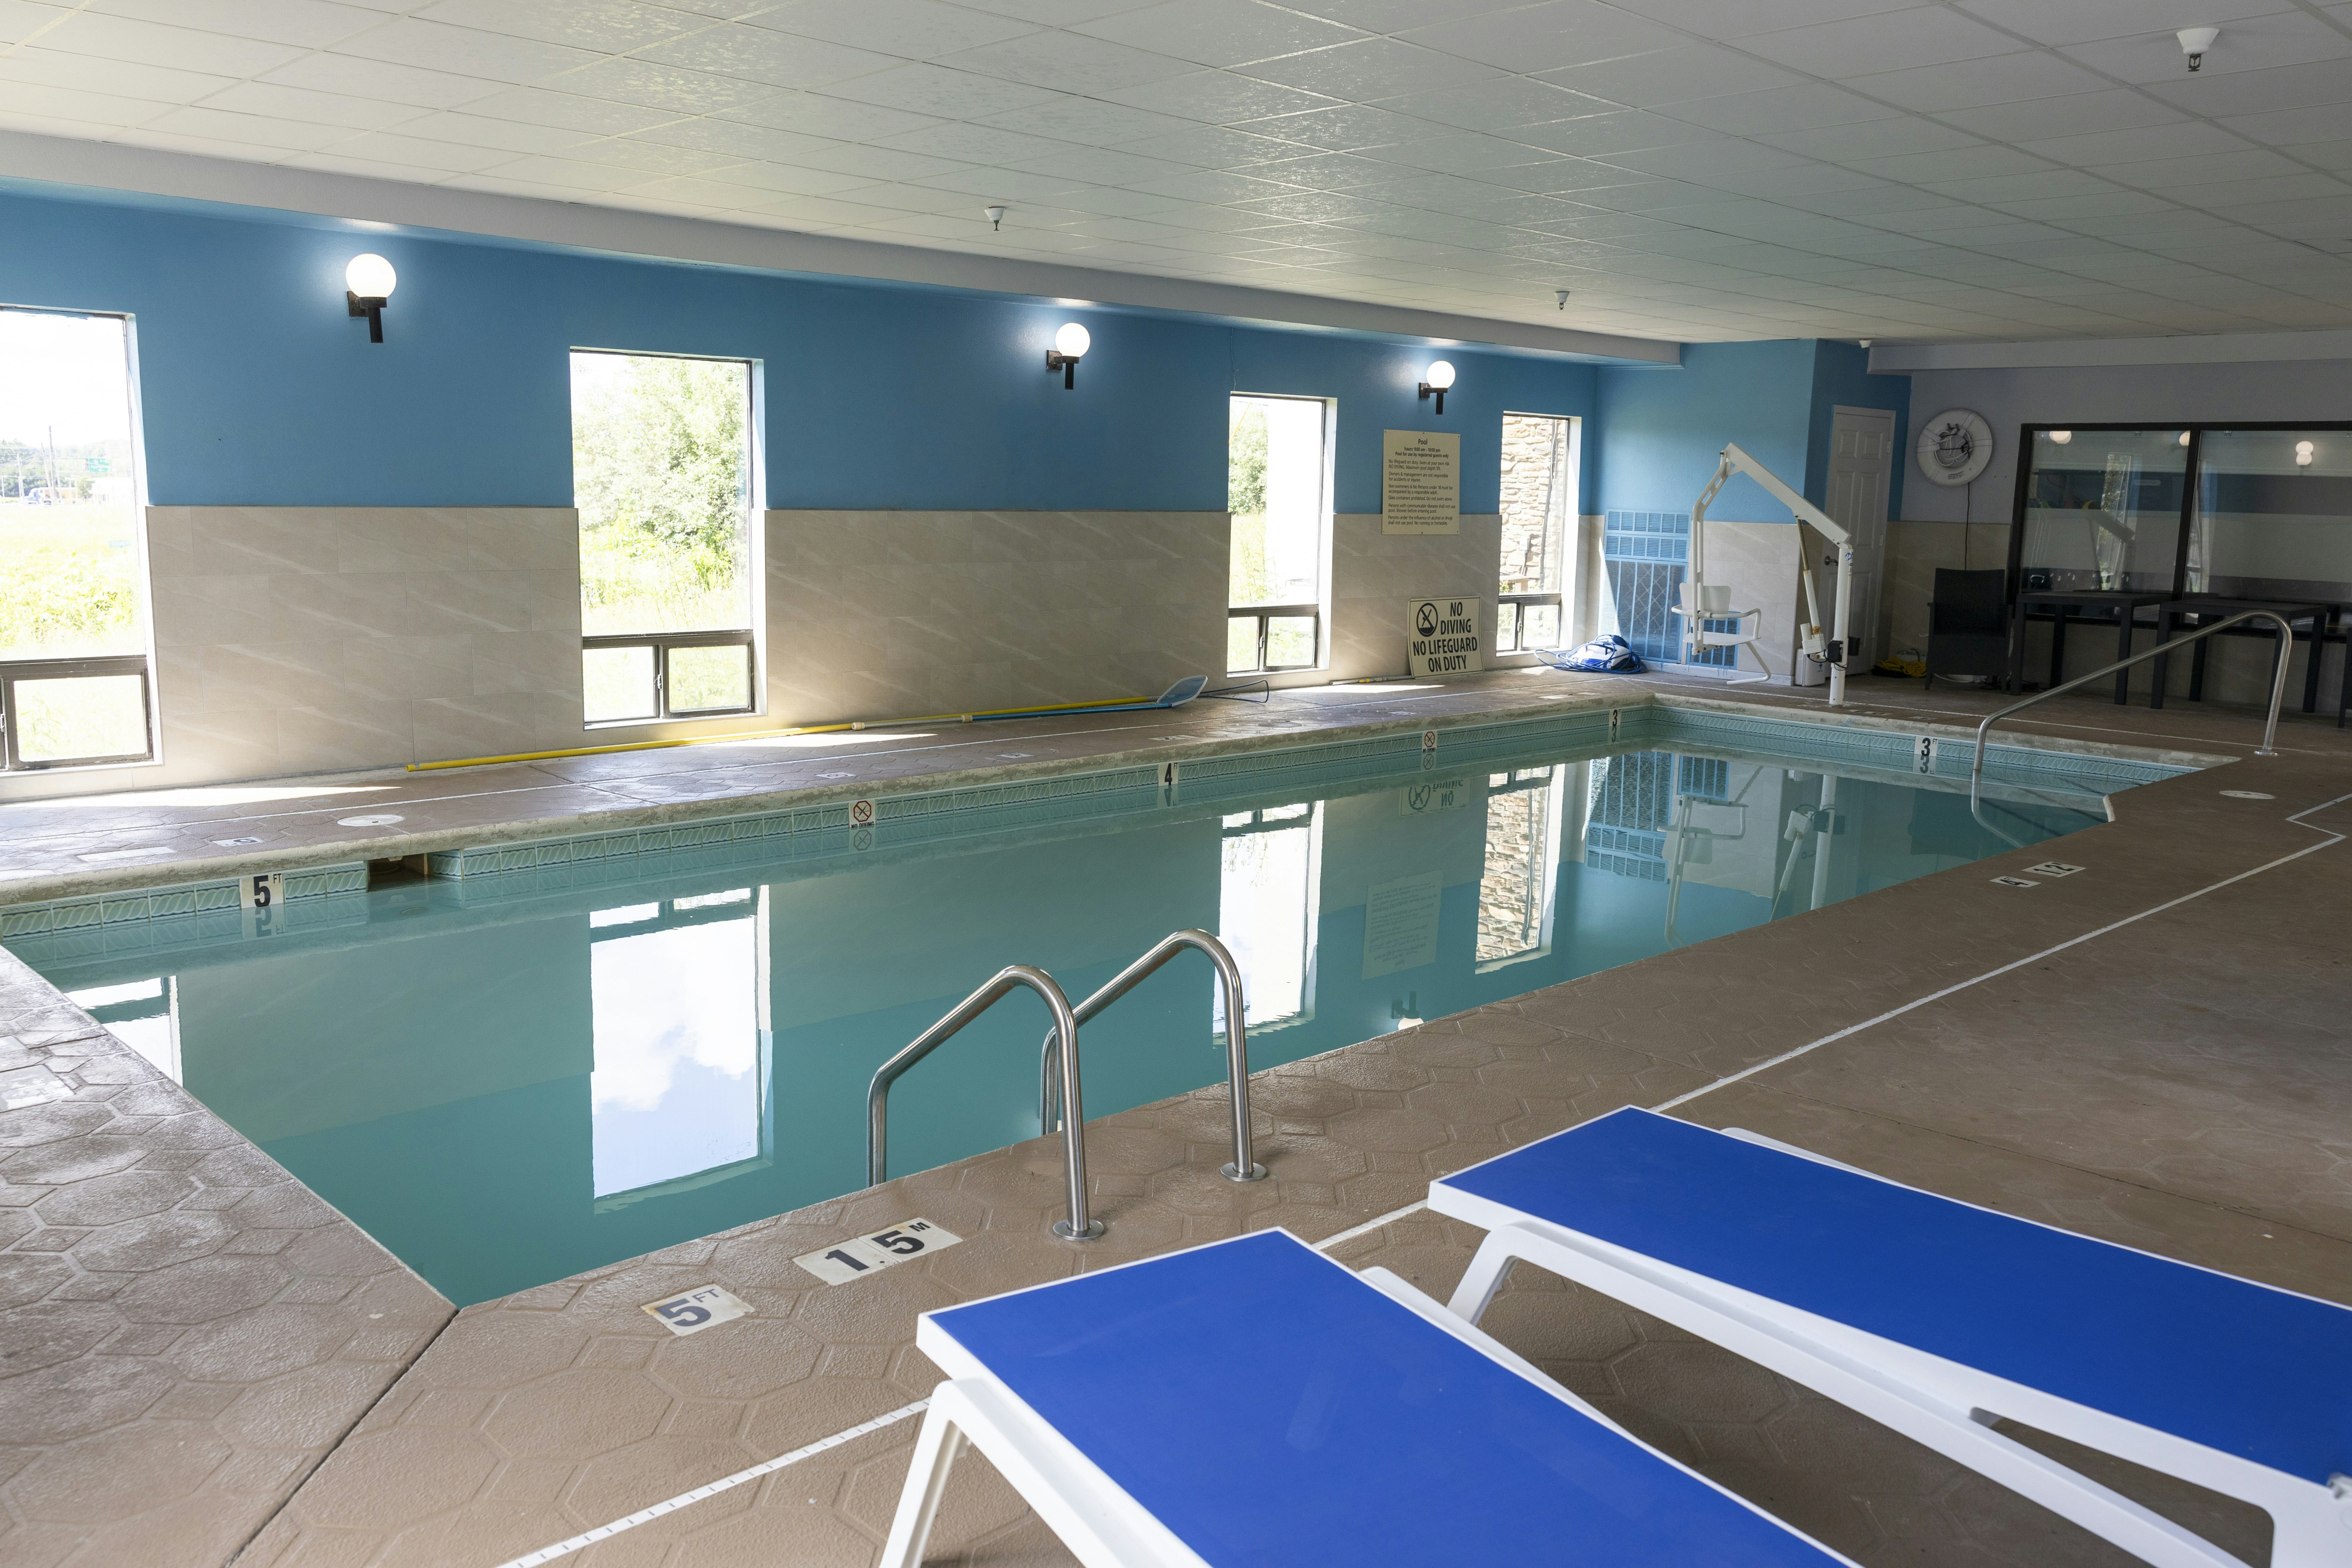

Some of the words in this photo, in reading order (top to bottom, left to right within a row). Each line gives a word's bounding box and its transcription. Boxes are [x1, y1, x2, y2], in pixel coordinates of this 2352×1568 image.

[1450, 602, 1462, 617] NO
[1440, 619, 1471, 635] DIVING
[1413, 640, 1426, 656] NO
[1429, 637, 1478, 655] LIFEGUARD
[1428, 657, 1441, 672] ON
[1444, 654, 1466, 671] DUTY
[1613, 709, 1618, 726] 3
[1921, 738, 1931, 756] 3
[1165, 763, 1172, 785] 4
[2033, 865, 2075, 875] 1.2
[254, 875, 271, 907] 5
[273, 873, 281, 884] FT
[908, 1222, 931, 1232] M
[655, 1298, 712, 1327] 5
[691, 1288, 721, 1303] FT
